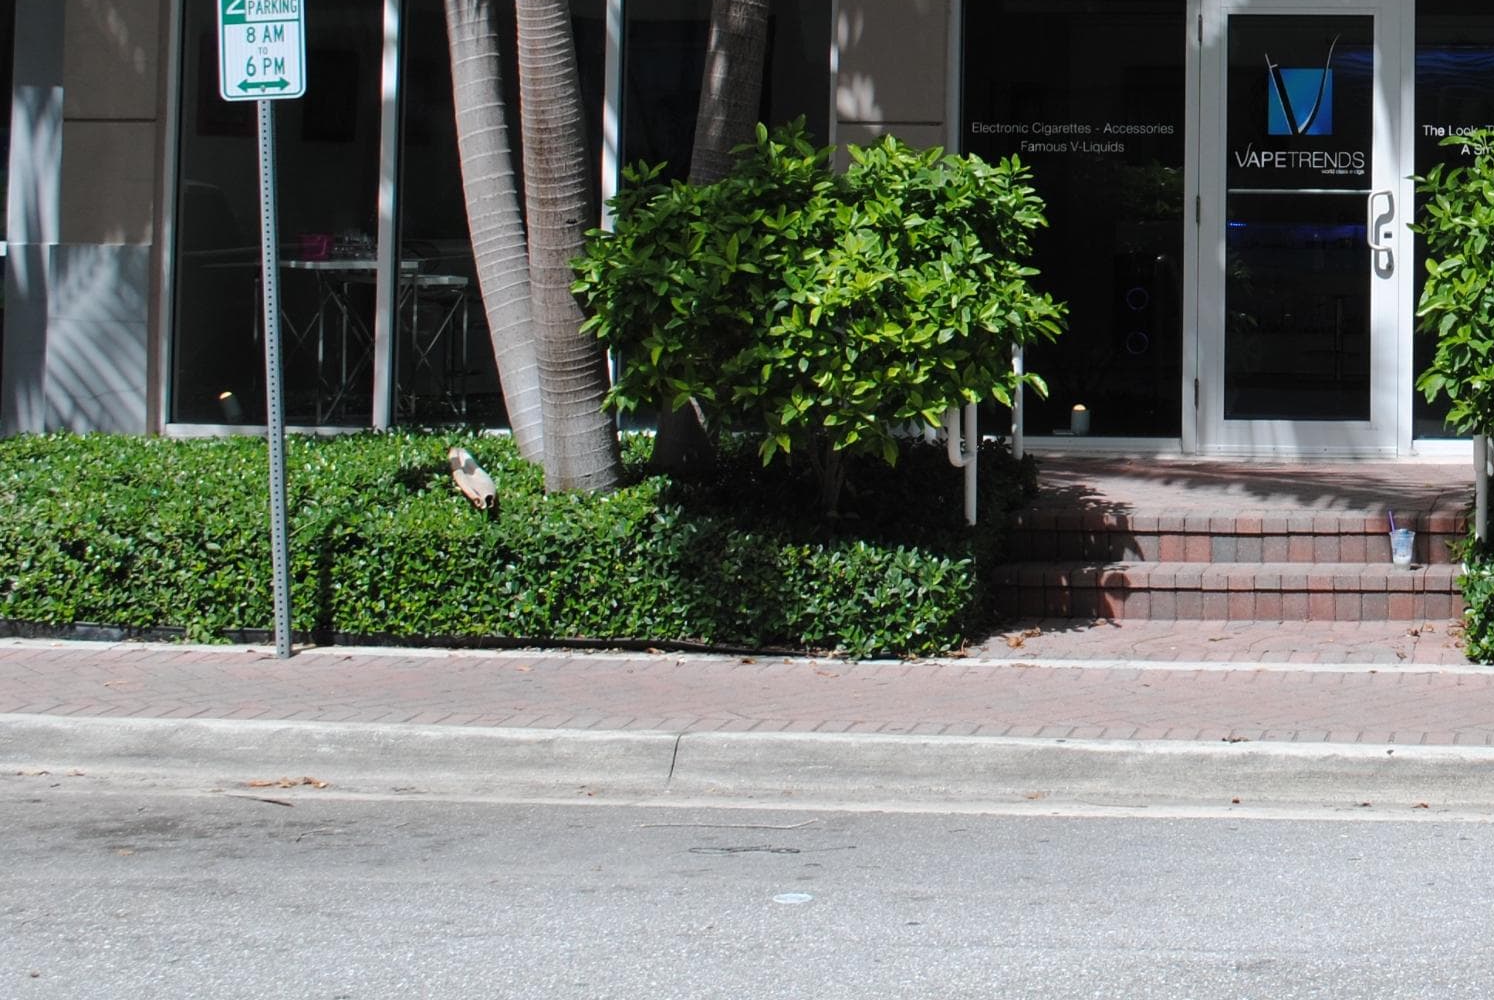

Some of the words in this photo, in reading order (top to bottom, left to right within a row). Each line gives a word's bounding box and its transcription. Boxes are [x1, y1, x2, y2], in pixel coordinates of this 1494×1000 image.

[246, 27, 256, 43] 8
[262, 24, 285, 43] AM
[258, 47, 268, 55] TO
[246, 56, 256, 77] 6
[263, 57, 285, 75] PM
[971, 122, 1029, 134] Electronic
[1032, 122, 1092, 136] Cigarettes
[1103, 122, 1174, 134] Accessories
[1422, 125, 1446, 137] The
[1020, 140, 1067, 152] Famous
[1070, 141, 1125, 154] V-Liquids
[1234, 142, 1365, 169] VAPETRENDS
